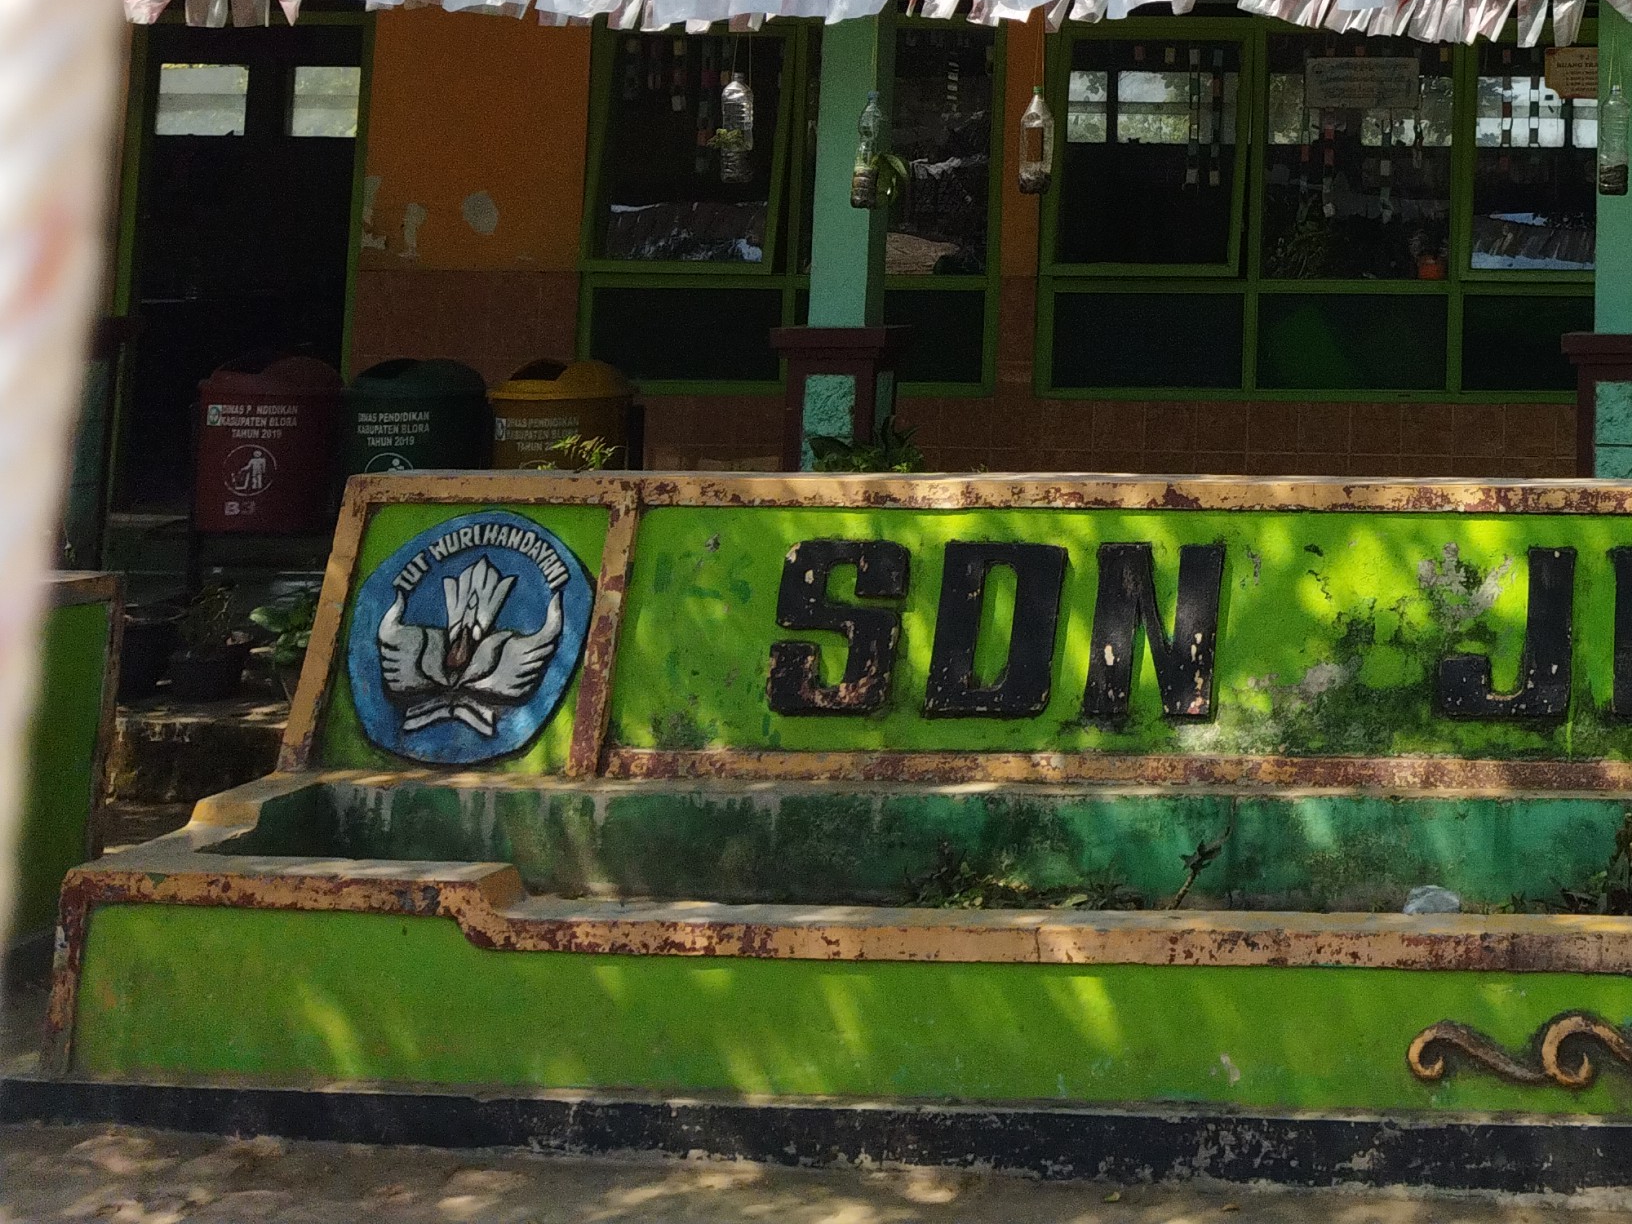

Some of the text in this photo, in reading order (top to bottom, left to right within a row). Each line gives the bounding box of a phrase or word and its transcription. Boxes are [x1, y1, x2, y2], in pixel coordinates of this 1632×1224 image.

[269, 417, 297, 428] BLORA
[358, 411, 430, 423] DINAS PENDIDIKAN
[231, 429, 282, 440] TAHUN 2019
[357, 423, 430, 436] KABUPATEN BLORA
[367, 436, 415, 448] TAHUN 2019
[392, 524, 570, 592] TUT WURI HANDAYANI
[767, 539, 1226, 720] SDN
